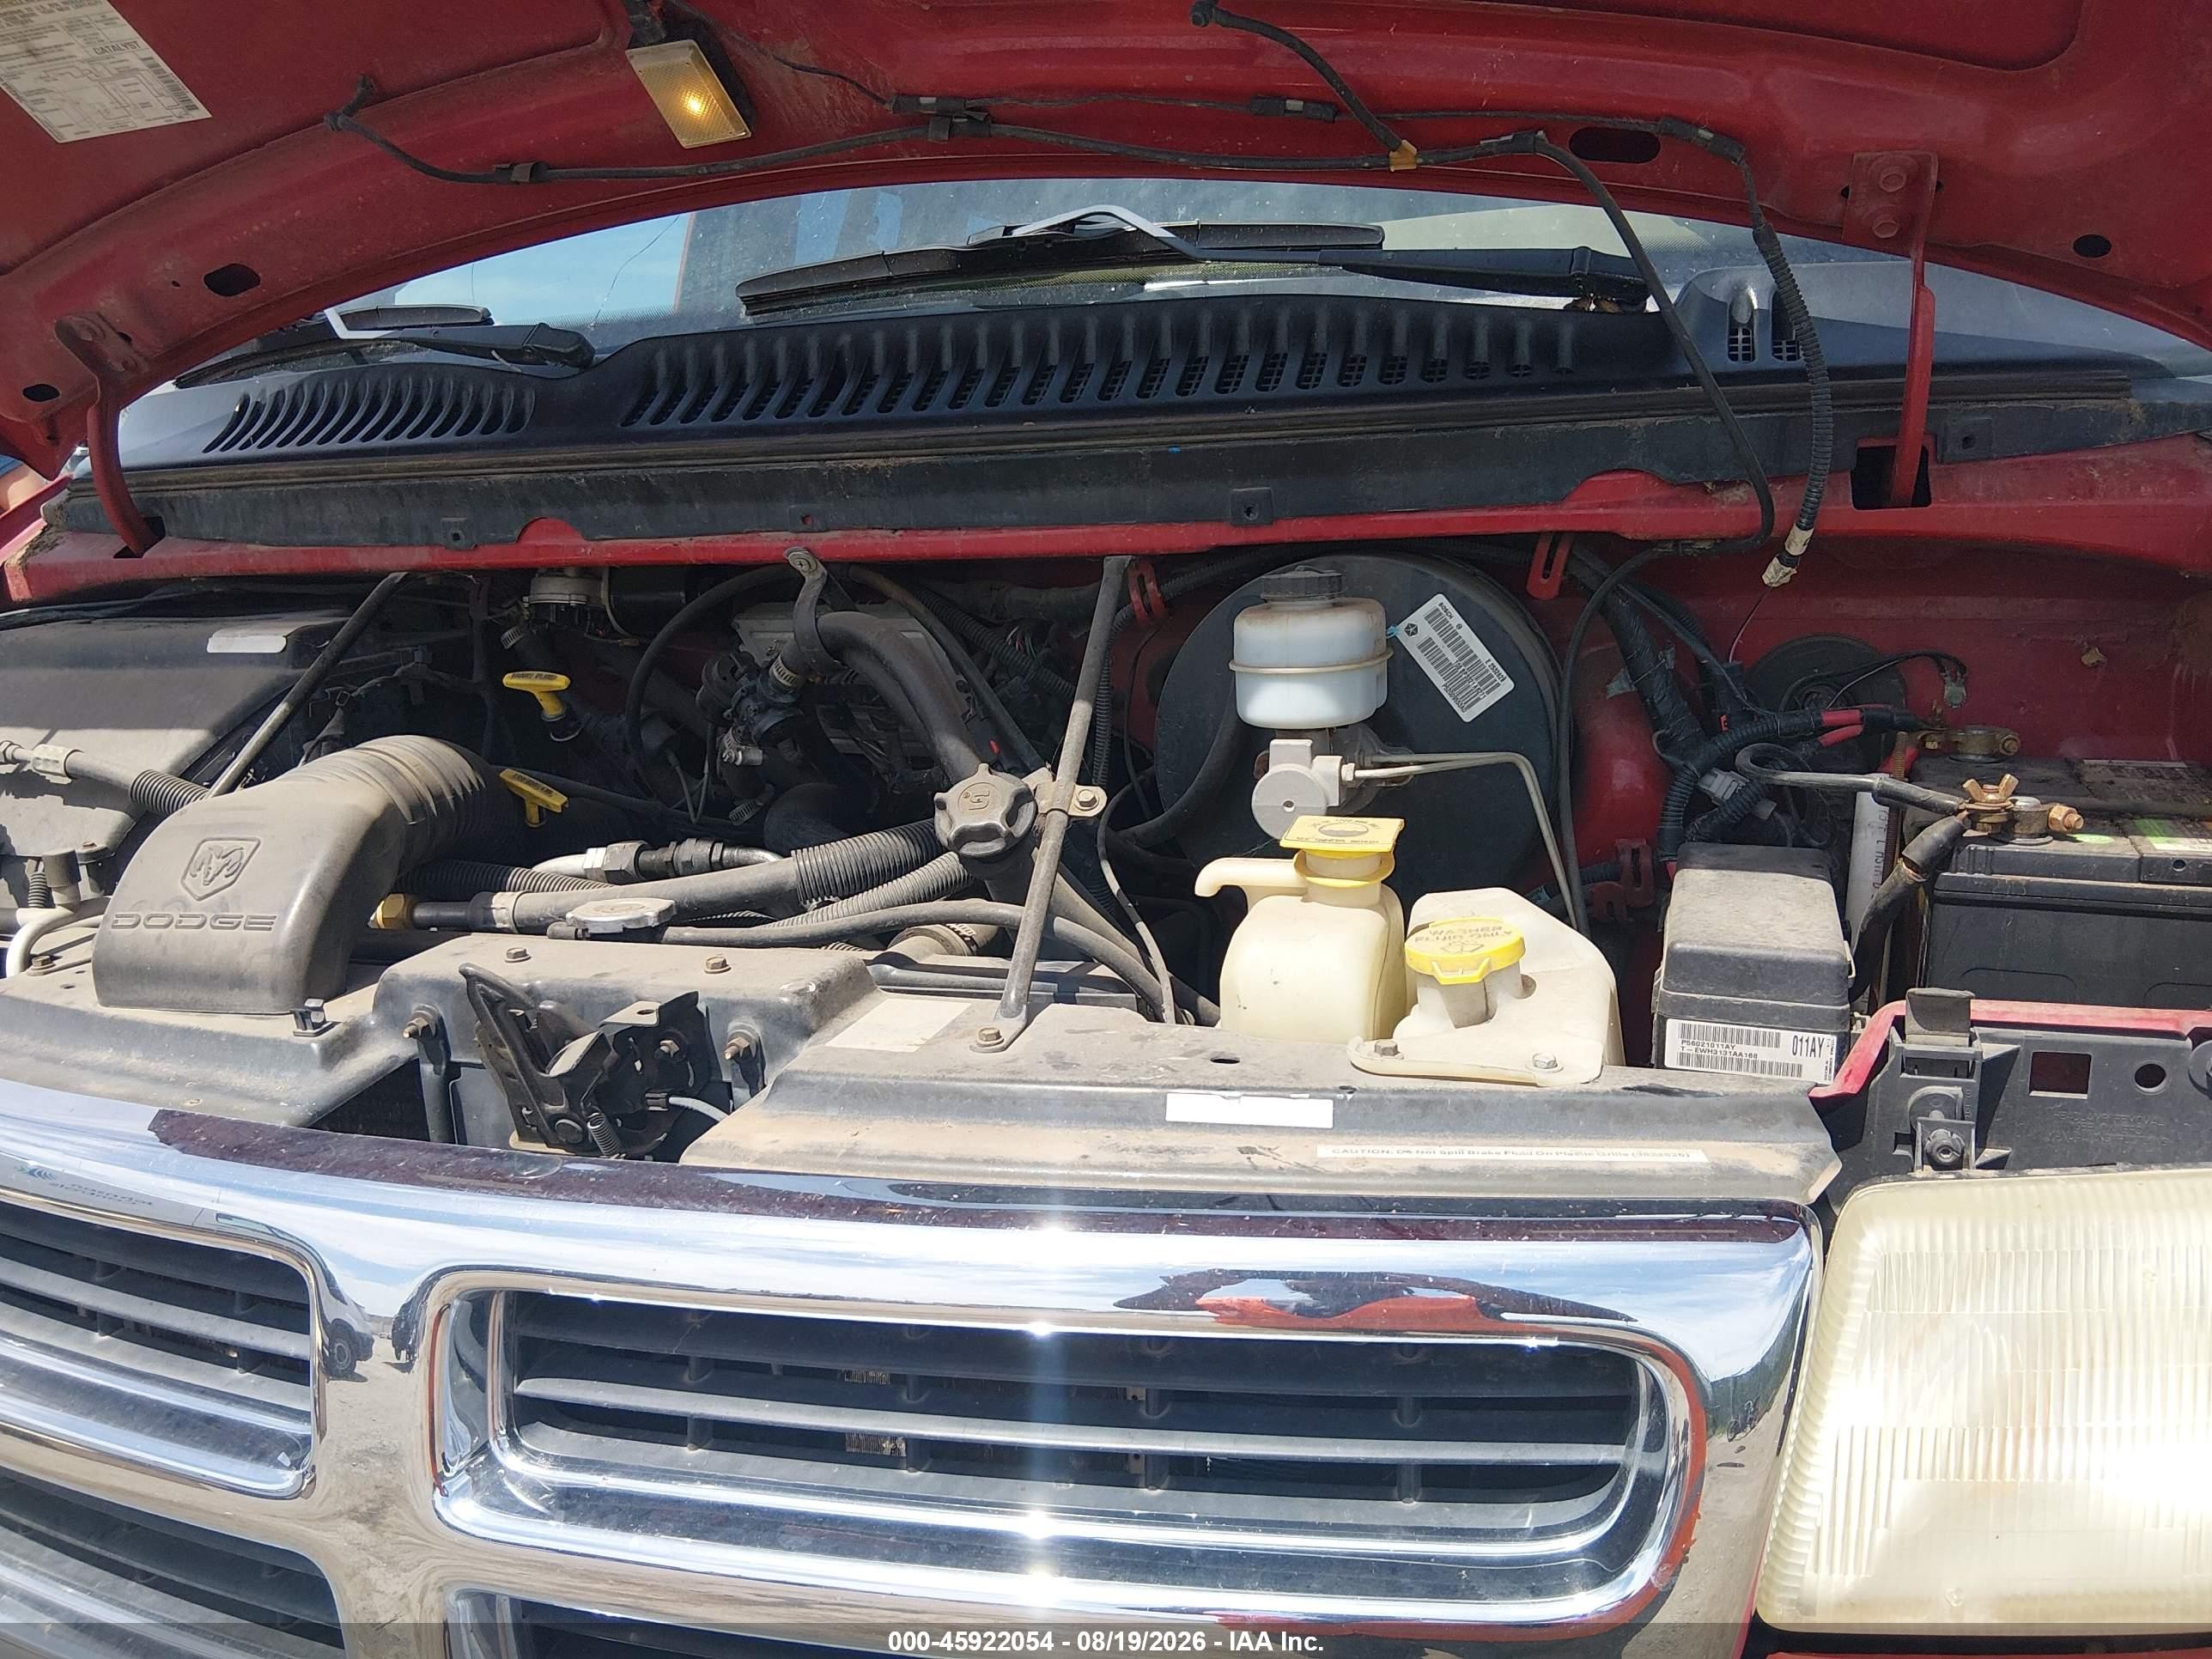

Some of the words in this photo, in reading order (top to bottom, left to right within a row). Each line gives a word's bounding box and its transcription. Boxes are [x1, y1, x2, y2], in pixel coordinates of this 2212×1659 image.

[92, 40, 141, 56] CATALYST
[1437, 602, 1455, 619] BOSCH
[111, 913, 277, 932] DODGE
[1414, 934, 1464, 944] FLUID
[1469, 930, 1512, 940] ONLY
[1429, 926, 1503, 936] WASHER
[1680, 1039, 1736, 1050] P56021011AY
[1792, 1035, 1826, 1058] 011AY
[1439, 1148, 1464, 1157] Spill
